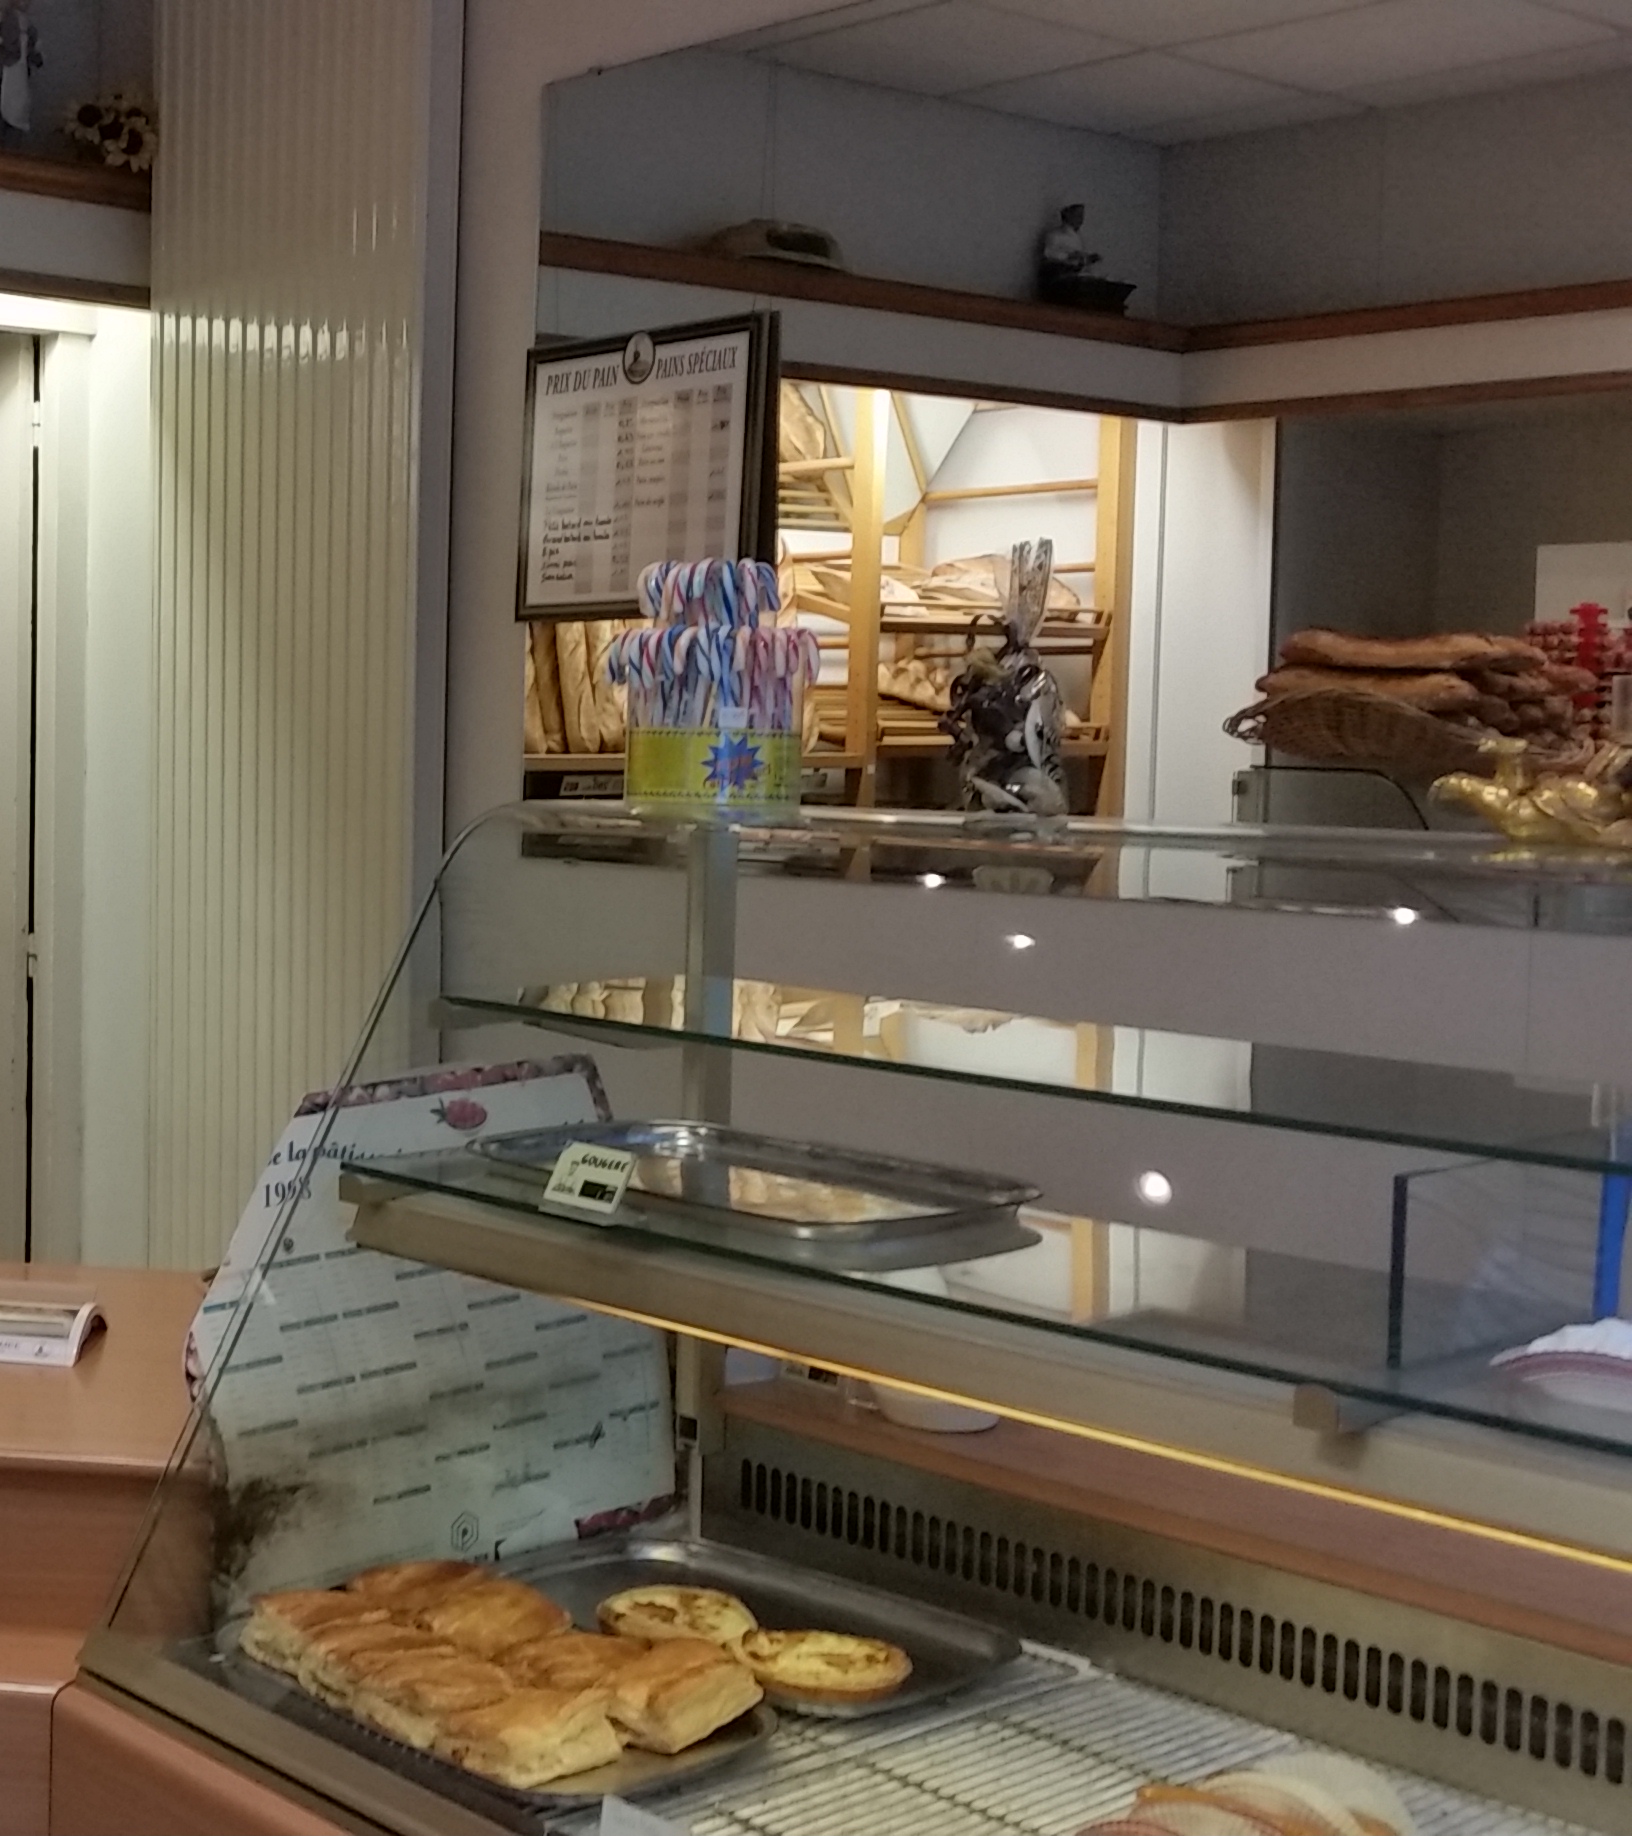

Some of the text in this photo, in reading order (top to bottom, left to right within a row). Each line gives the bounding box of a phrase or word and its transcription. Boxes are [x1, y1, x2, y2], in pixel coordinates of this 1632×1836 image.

[656, 346, 739, 380] PAINS SPÉCIAUX
[546, 364, 620, 395] PRIX DU PAIN
